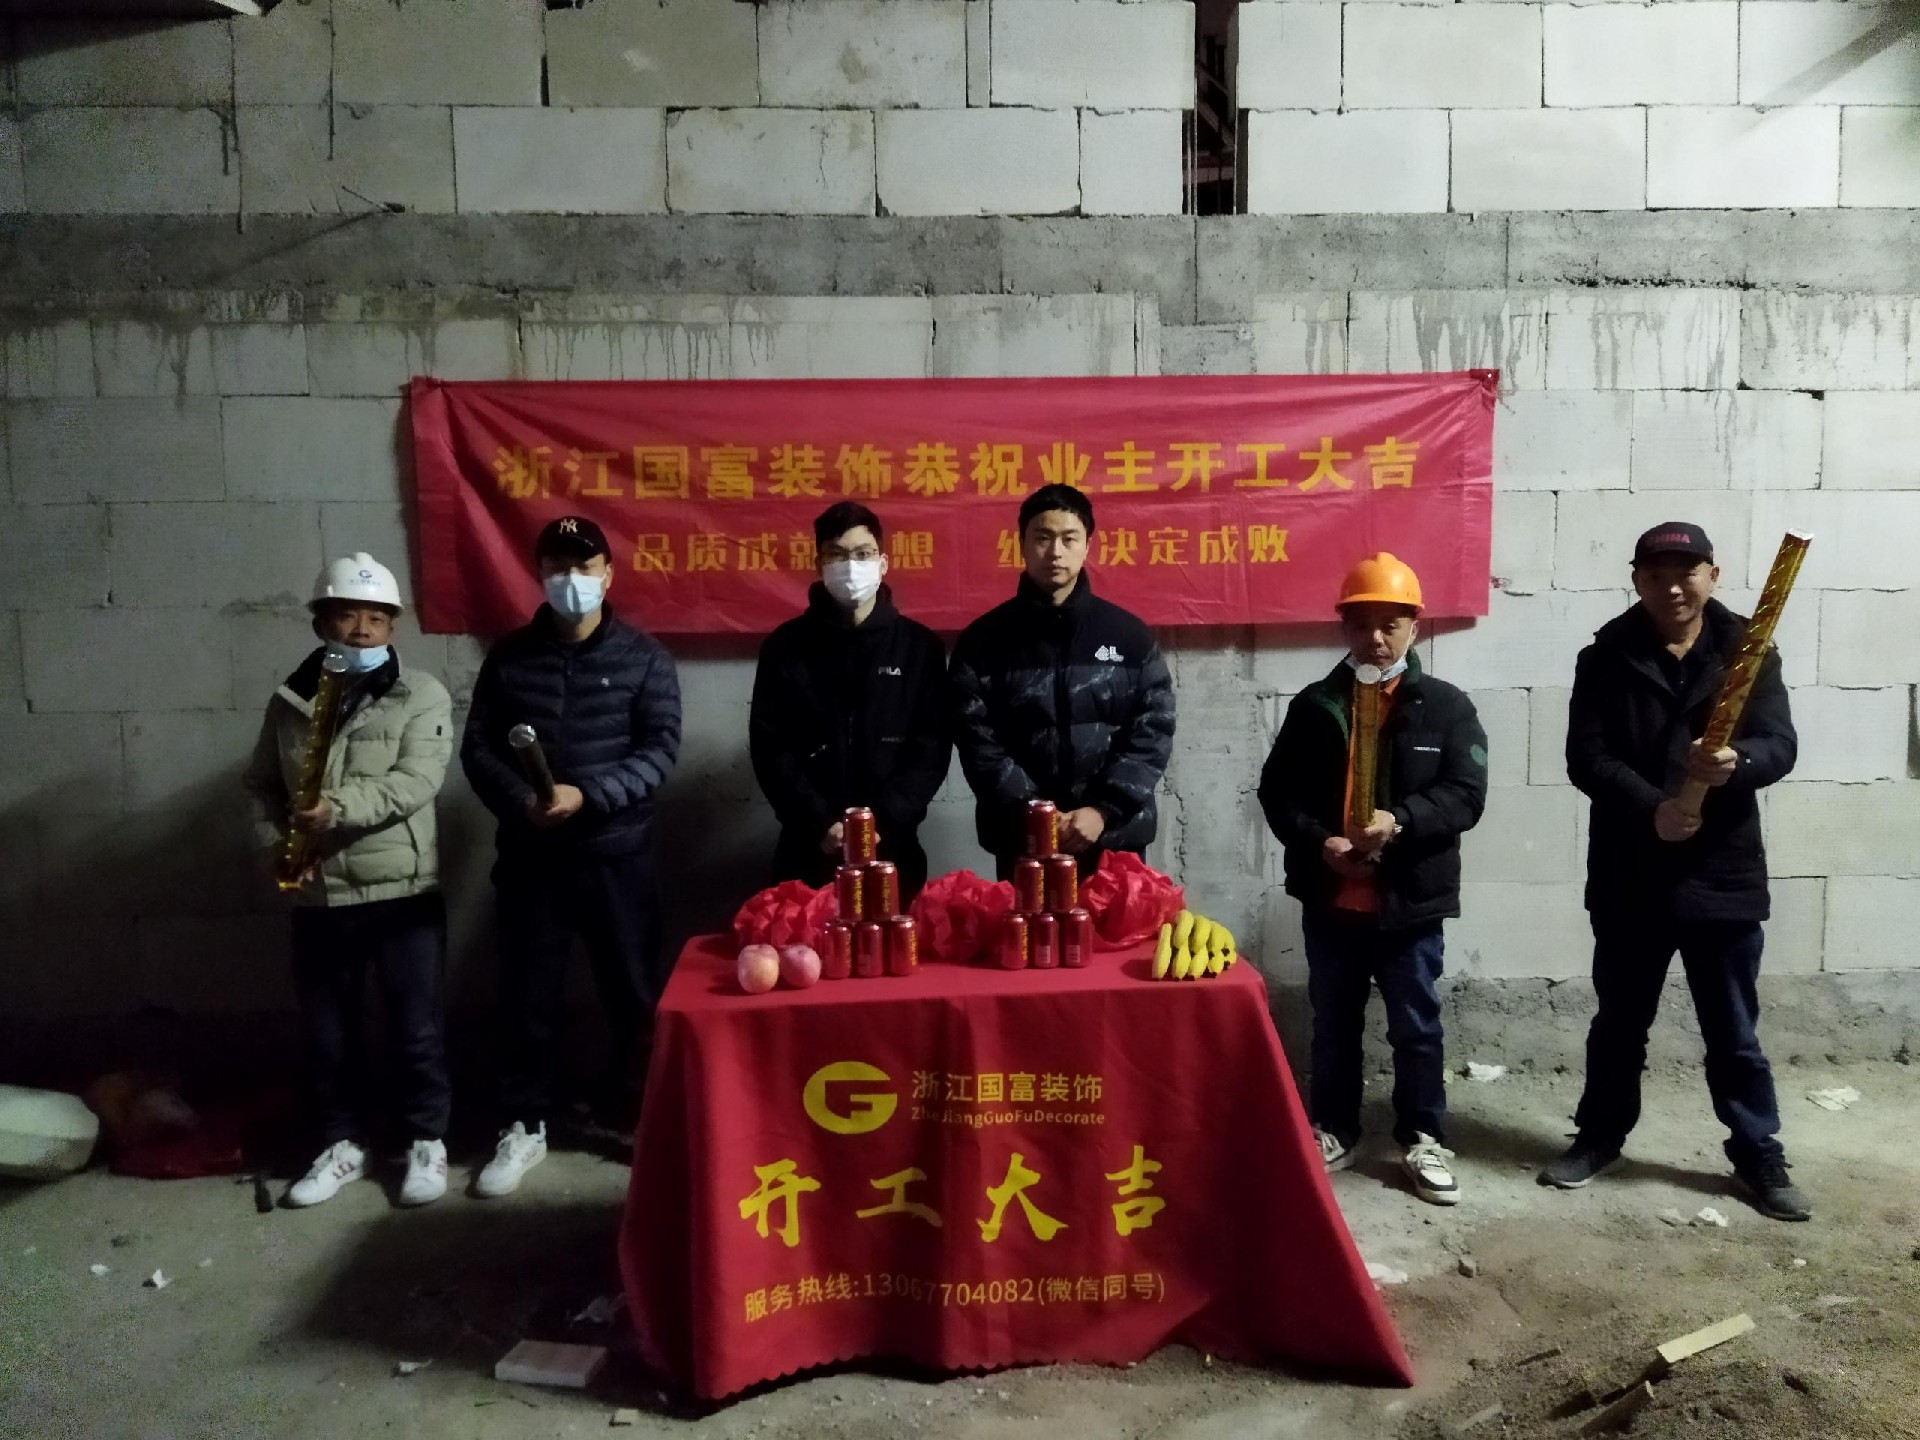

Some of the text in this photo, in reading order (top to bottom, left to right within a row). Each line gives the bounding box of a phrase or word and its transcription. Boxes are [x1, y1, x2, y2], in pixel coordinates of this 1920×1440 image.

[493, 436, 1421, 498] 浙江国富装饰恭祝业主开工大吉
[633, 524, 1290, 571] 品质成就想 细决定成败
[911, 1070, 1104, 1103] 浙江国富装饰
[738, 1145, 1166, 1248] 开工大吉
